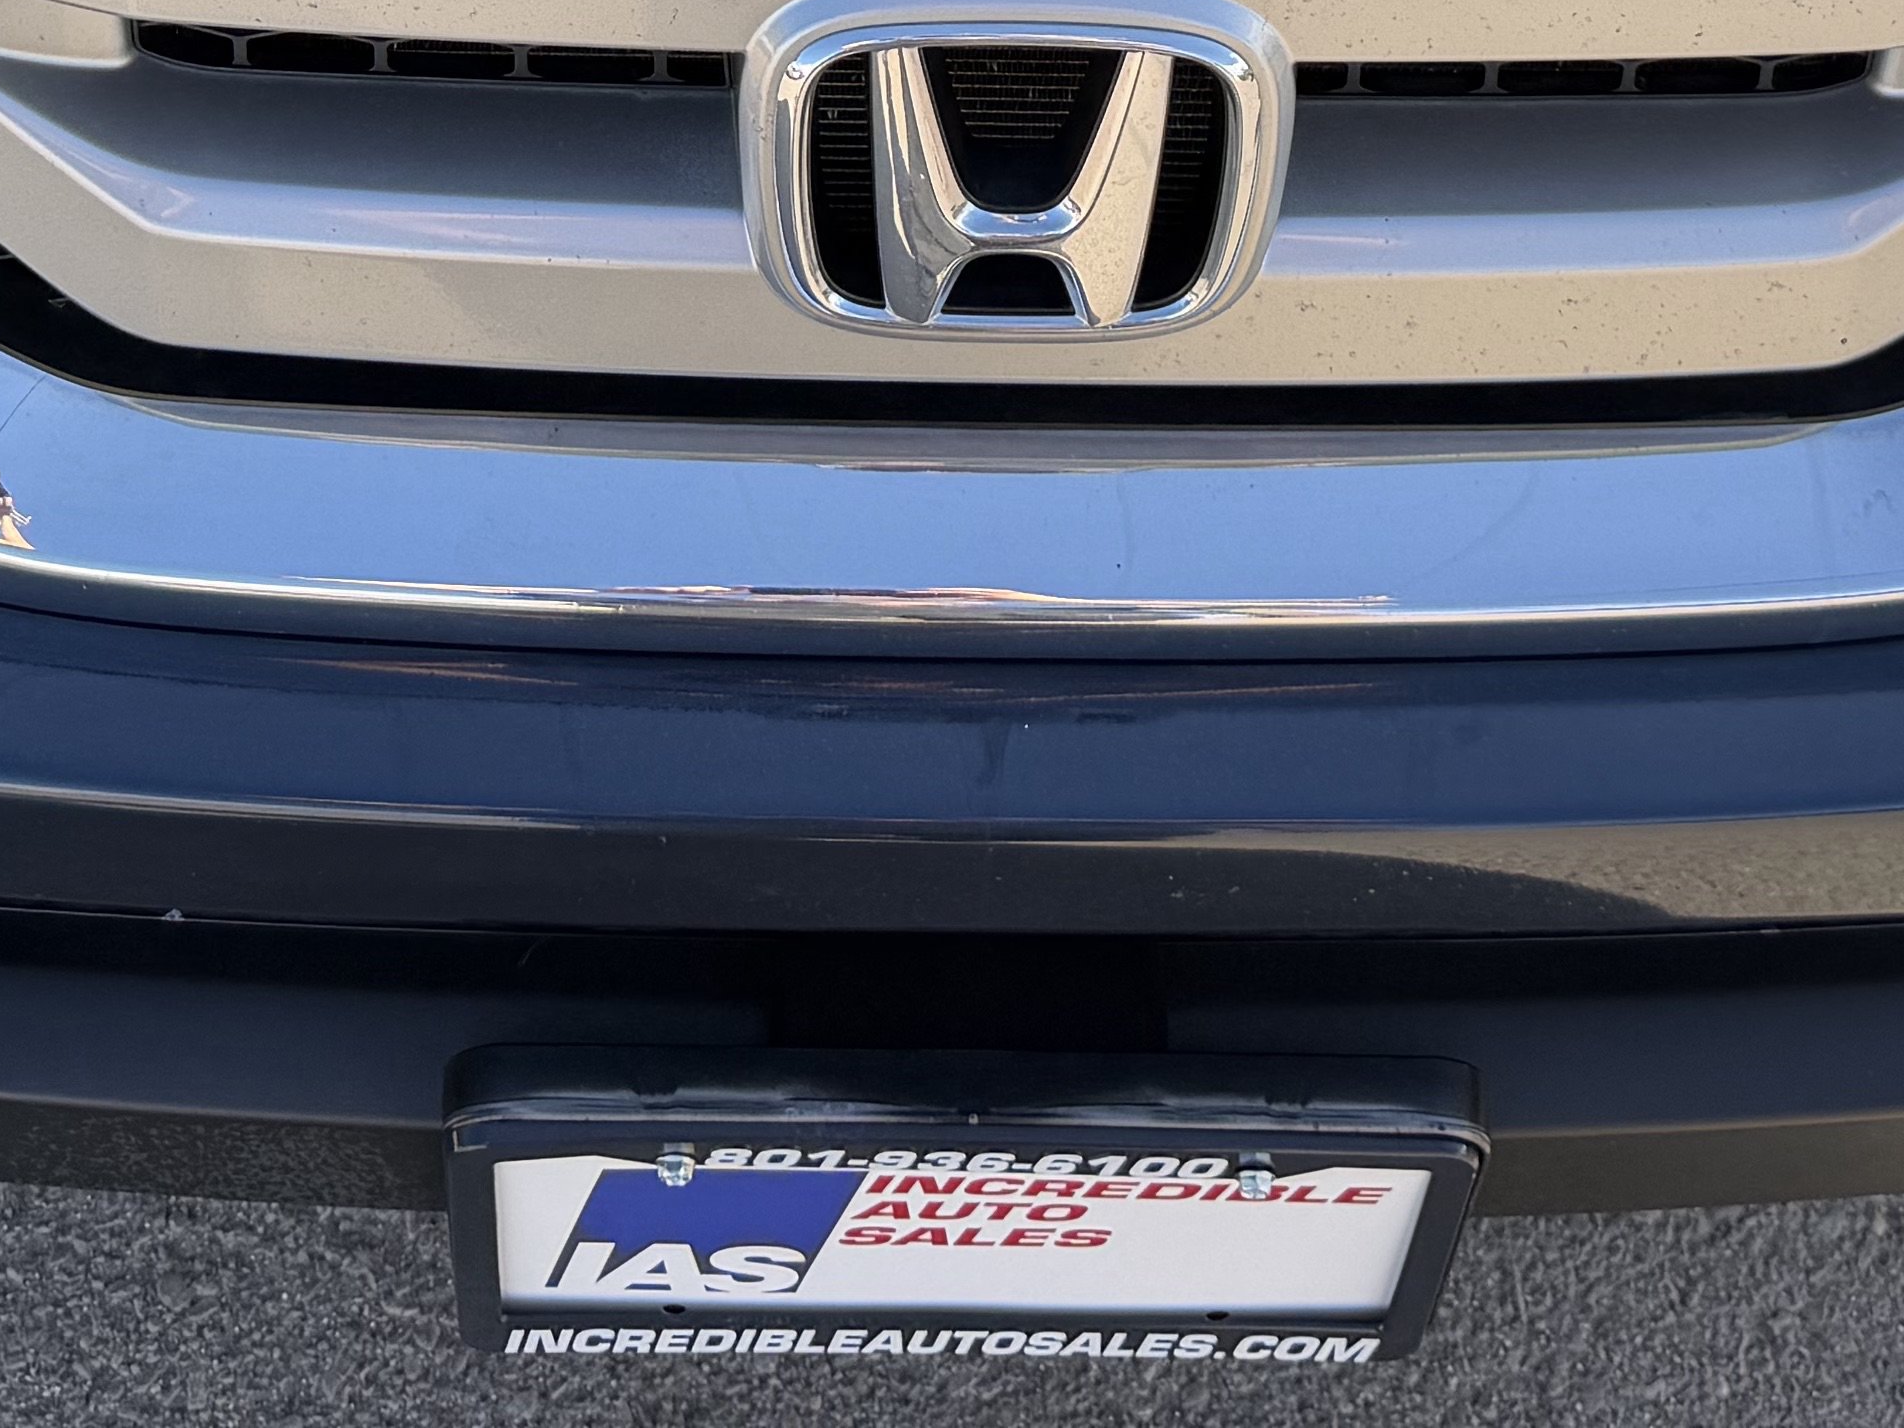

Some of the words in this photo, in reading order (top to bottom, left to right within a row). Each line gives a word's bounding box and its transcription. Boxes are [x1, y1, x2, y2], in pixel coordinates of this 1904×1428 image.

[704, 1147, 1230, 1178] 801-936-6100
[850, 1201, 1089, 1222] AUTO
[838, 1226, 1113, 1248] SALES
[556, 1241, 807, 1293] IAS
[503, 1327, 1382, 1363] INCREDIBLEAUTOSALES.COM
